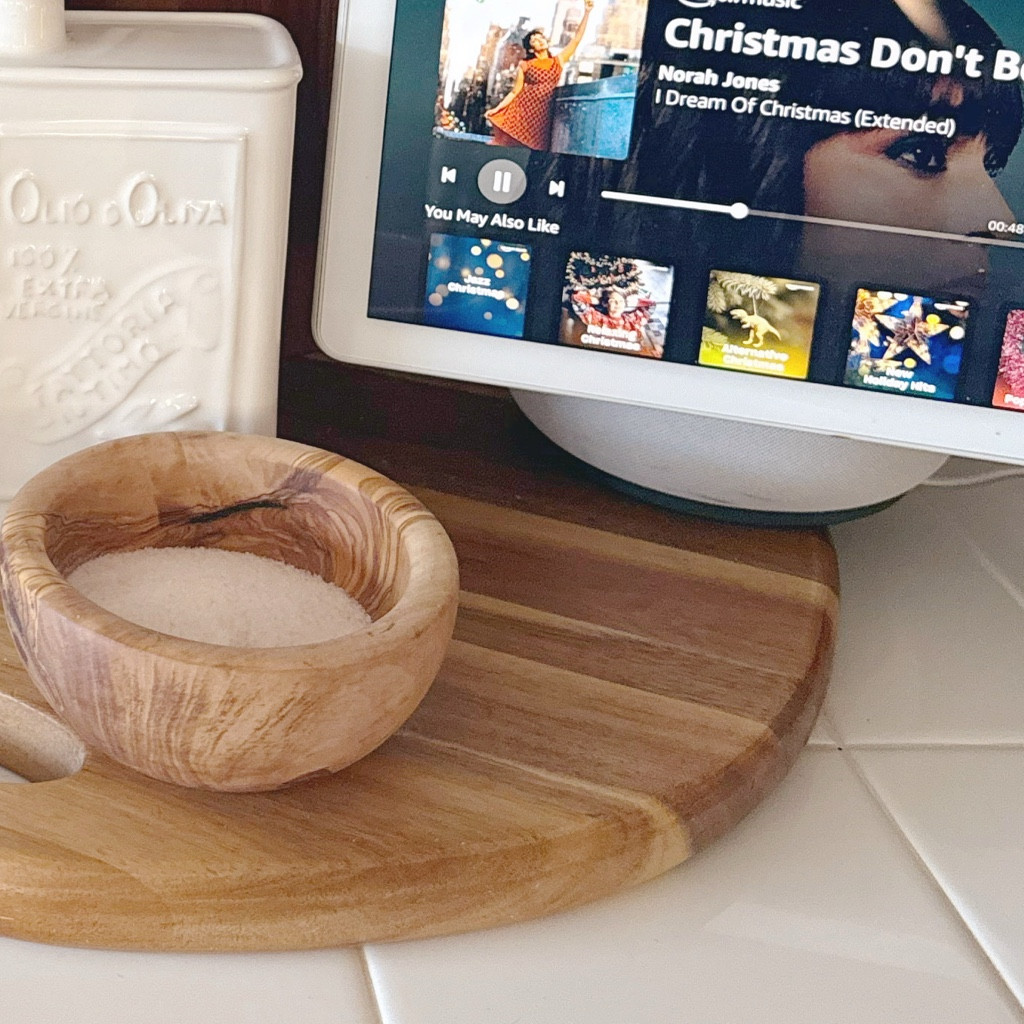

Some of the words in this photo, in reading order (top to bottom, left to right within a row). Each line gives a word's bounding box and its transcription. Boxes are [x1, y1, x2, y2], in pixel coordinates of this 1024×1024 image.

[664, 17, 861, 66] Christmas
[870, 37, 984, 78] Don't
[992, 49, 1024, 82] B
[658, 65, 719, 87] Norah
[722, 71, 781, 93] Jones
[655, 88, 661, 104] I
[665, 90, 727, 111] Dream
[731, 94, 758, 114] Of
[760, 97, 852, 125] Christmas
[854, 108, 957, 138] (Extended)
[425, 204, 453, 221] You
[456, 208, 488, 227] May
[490, 213, 525, 231] Also
[527, 218, 561, 235] Like
[447, 282, 506, 301] Christmas
[580, 333, 641, 352] Christmas
[863, 375, 909, 391] Holiday
